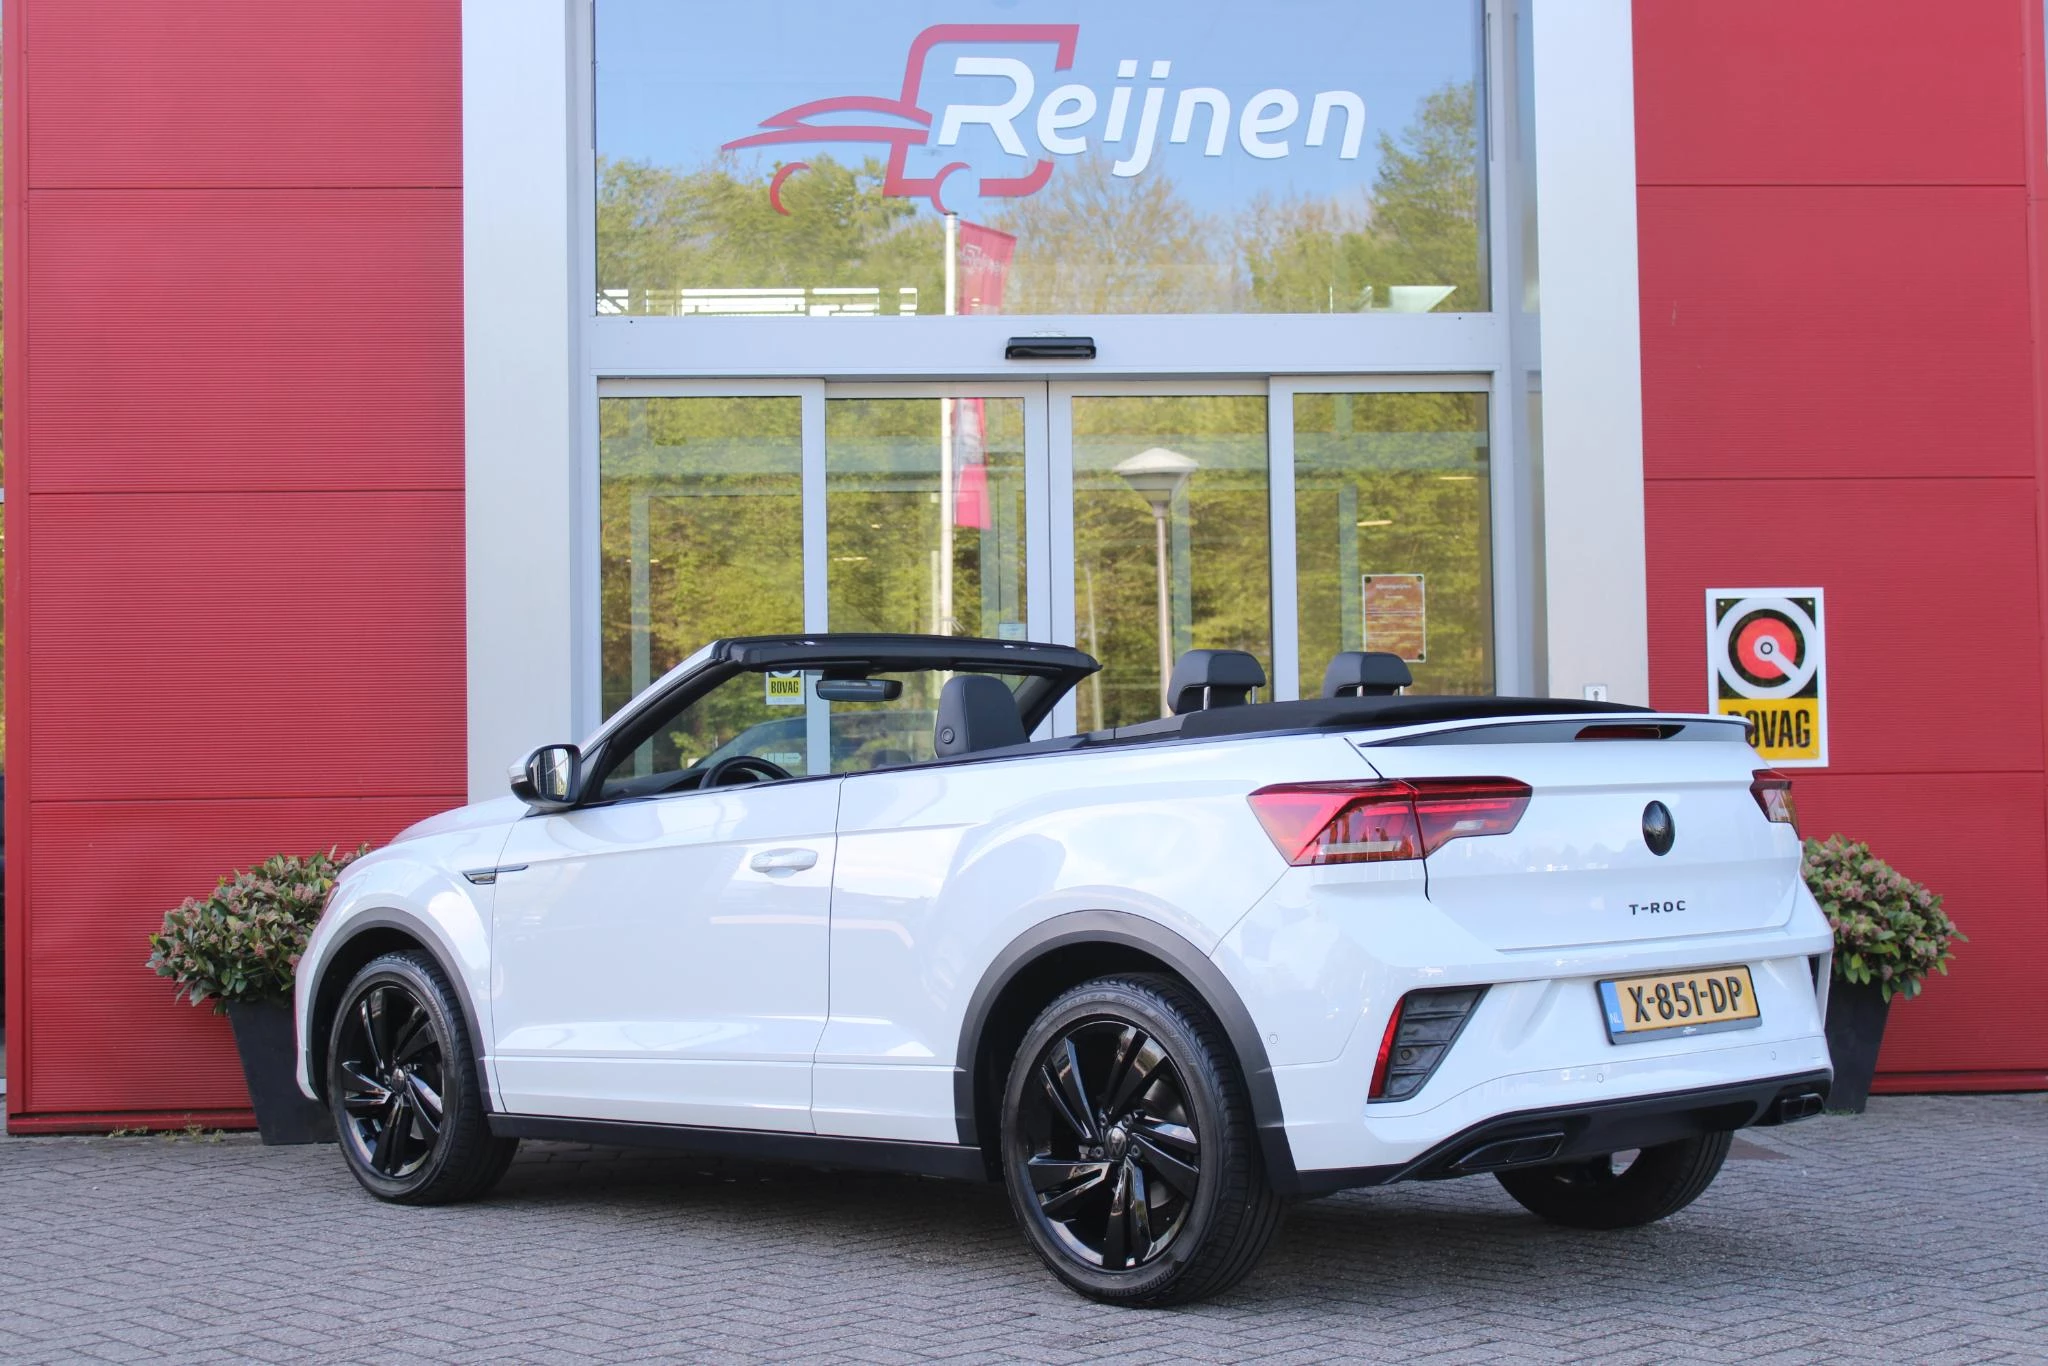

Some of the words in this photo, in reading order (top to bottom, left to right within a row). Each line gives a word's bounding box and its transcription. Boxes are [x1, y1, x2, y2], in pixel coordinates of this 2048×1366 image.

[937, 57, 1366, 178] Reijnen
[770, 680, 799, 694] BOVAG
[1727, 709, 1810, 748] OVAG
[1629, 900, 1687, 916] T-ROC
[1627, 976, 1743, 1023] X-851-DP
